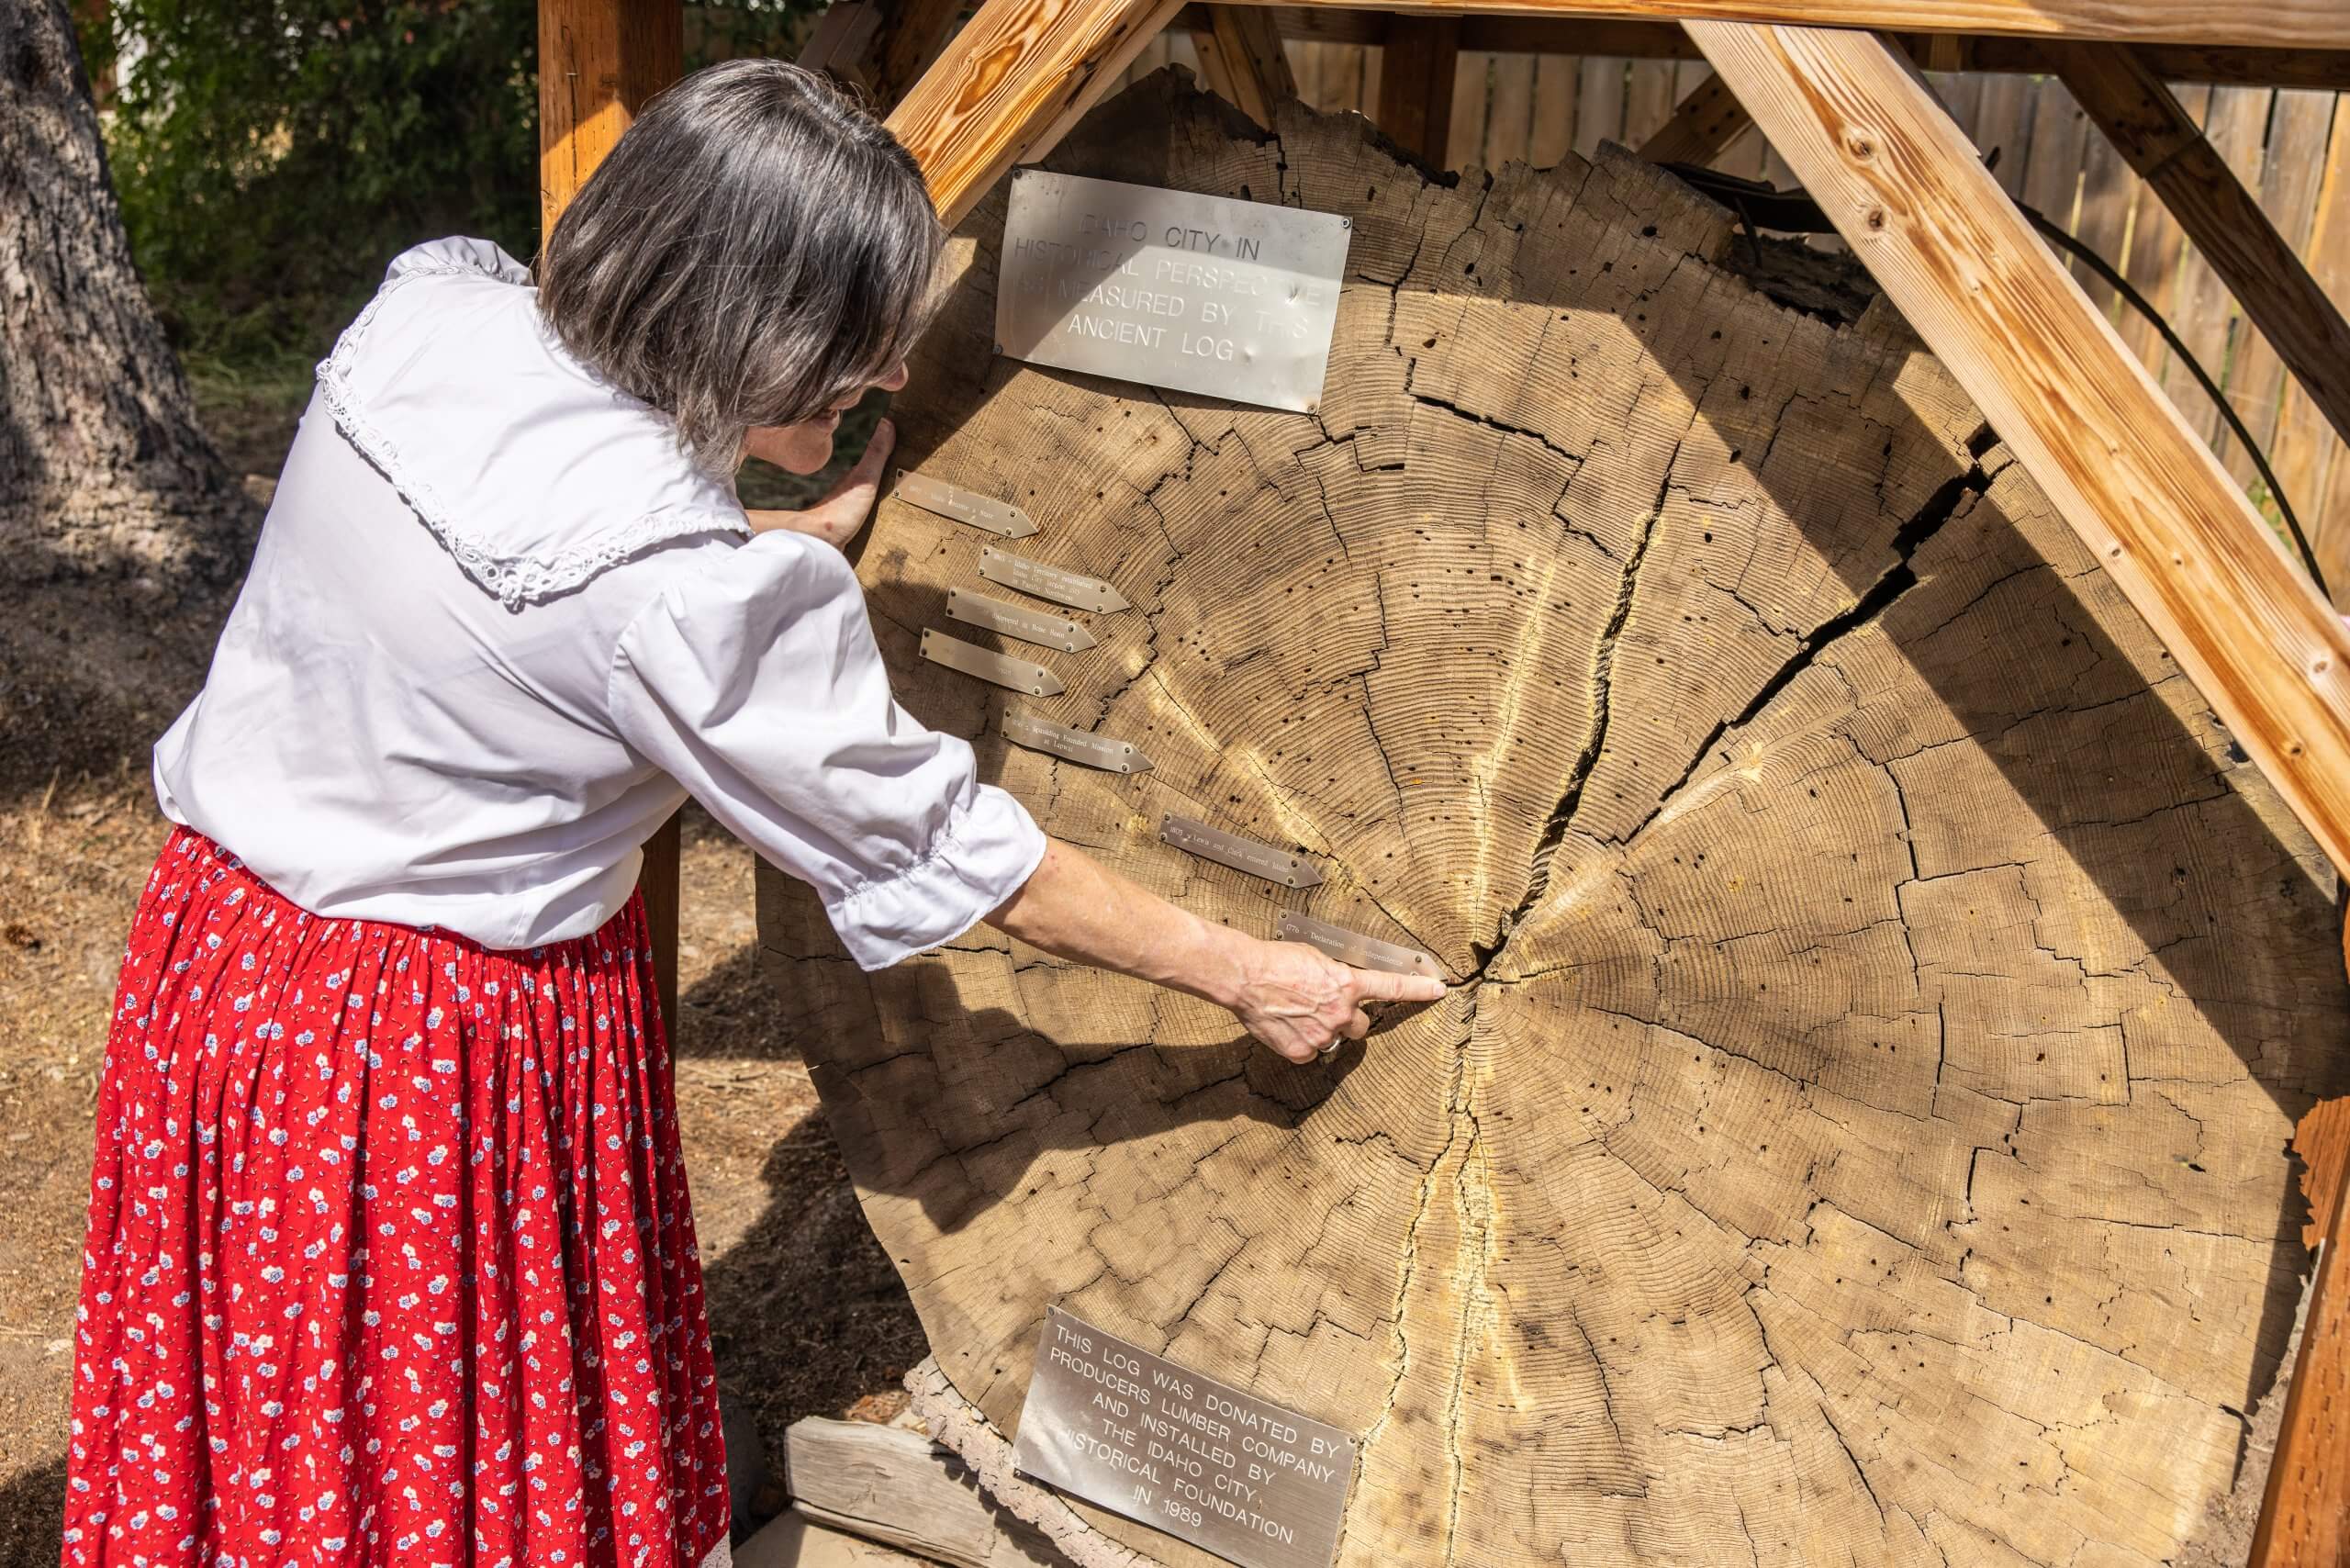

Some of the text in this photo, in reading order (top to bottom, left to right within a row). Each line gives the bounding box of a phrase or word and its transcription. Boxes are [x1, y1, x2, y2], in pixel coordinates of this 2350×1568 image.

[1013, 237, 1323, 308] HISTORICAL PERSPECE
[1164, 226, 1222, 253] CITY
[1236, 237, 1260, 262] IN
[1058, 279, 1185, 319] MEASURED
[1201, 301, 1235, 327] BY
[1255, 310, 1309, 339] THIS
[1067, 314, 1234, 362] ANCIENT LOG
[1285, 924, 1301, 935] 1776
[1310, 932, 1345, 949] Declaration
[1362, 950, 1404, 967] ndependence
[1049, 1348, 1337, 1484] PRODUCERS LUMBER COMPANY
[1056, 1326, 1342, 1460] THIS LOG WAS DONATED BY
[1091, 1392, 1277, 1486] AND INSTALLED BY
[1102, 1418, 1258, 1503] THE IDAHO CITY
[1133, 1484, 1203, 1529] IN 1989
[1173, 1480, 1295, 1545] FOUNDATION
